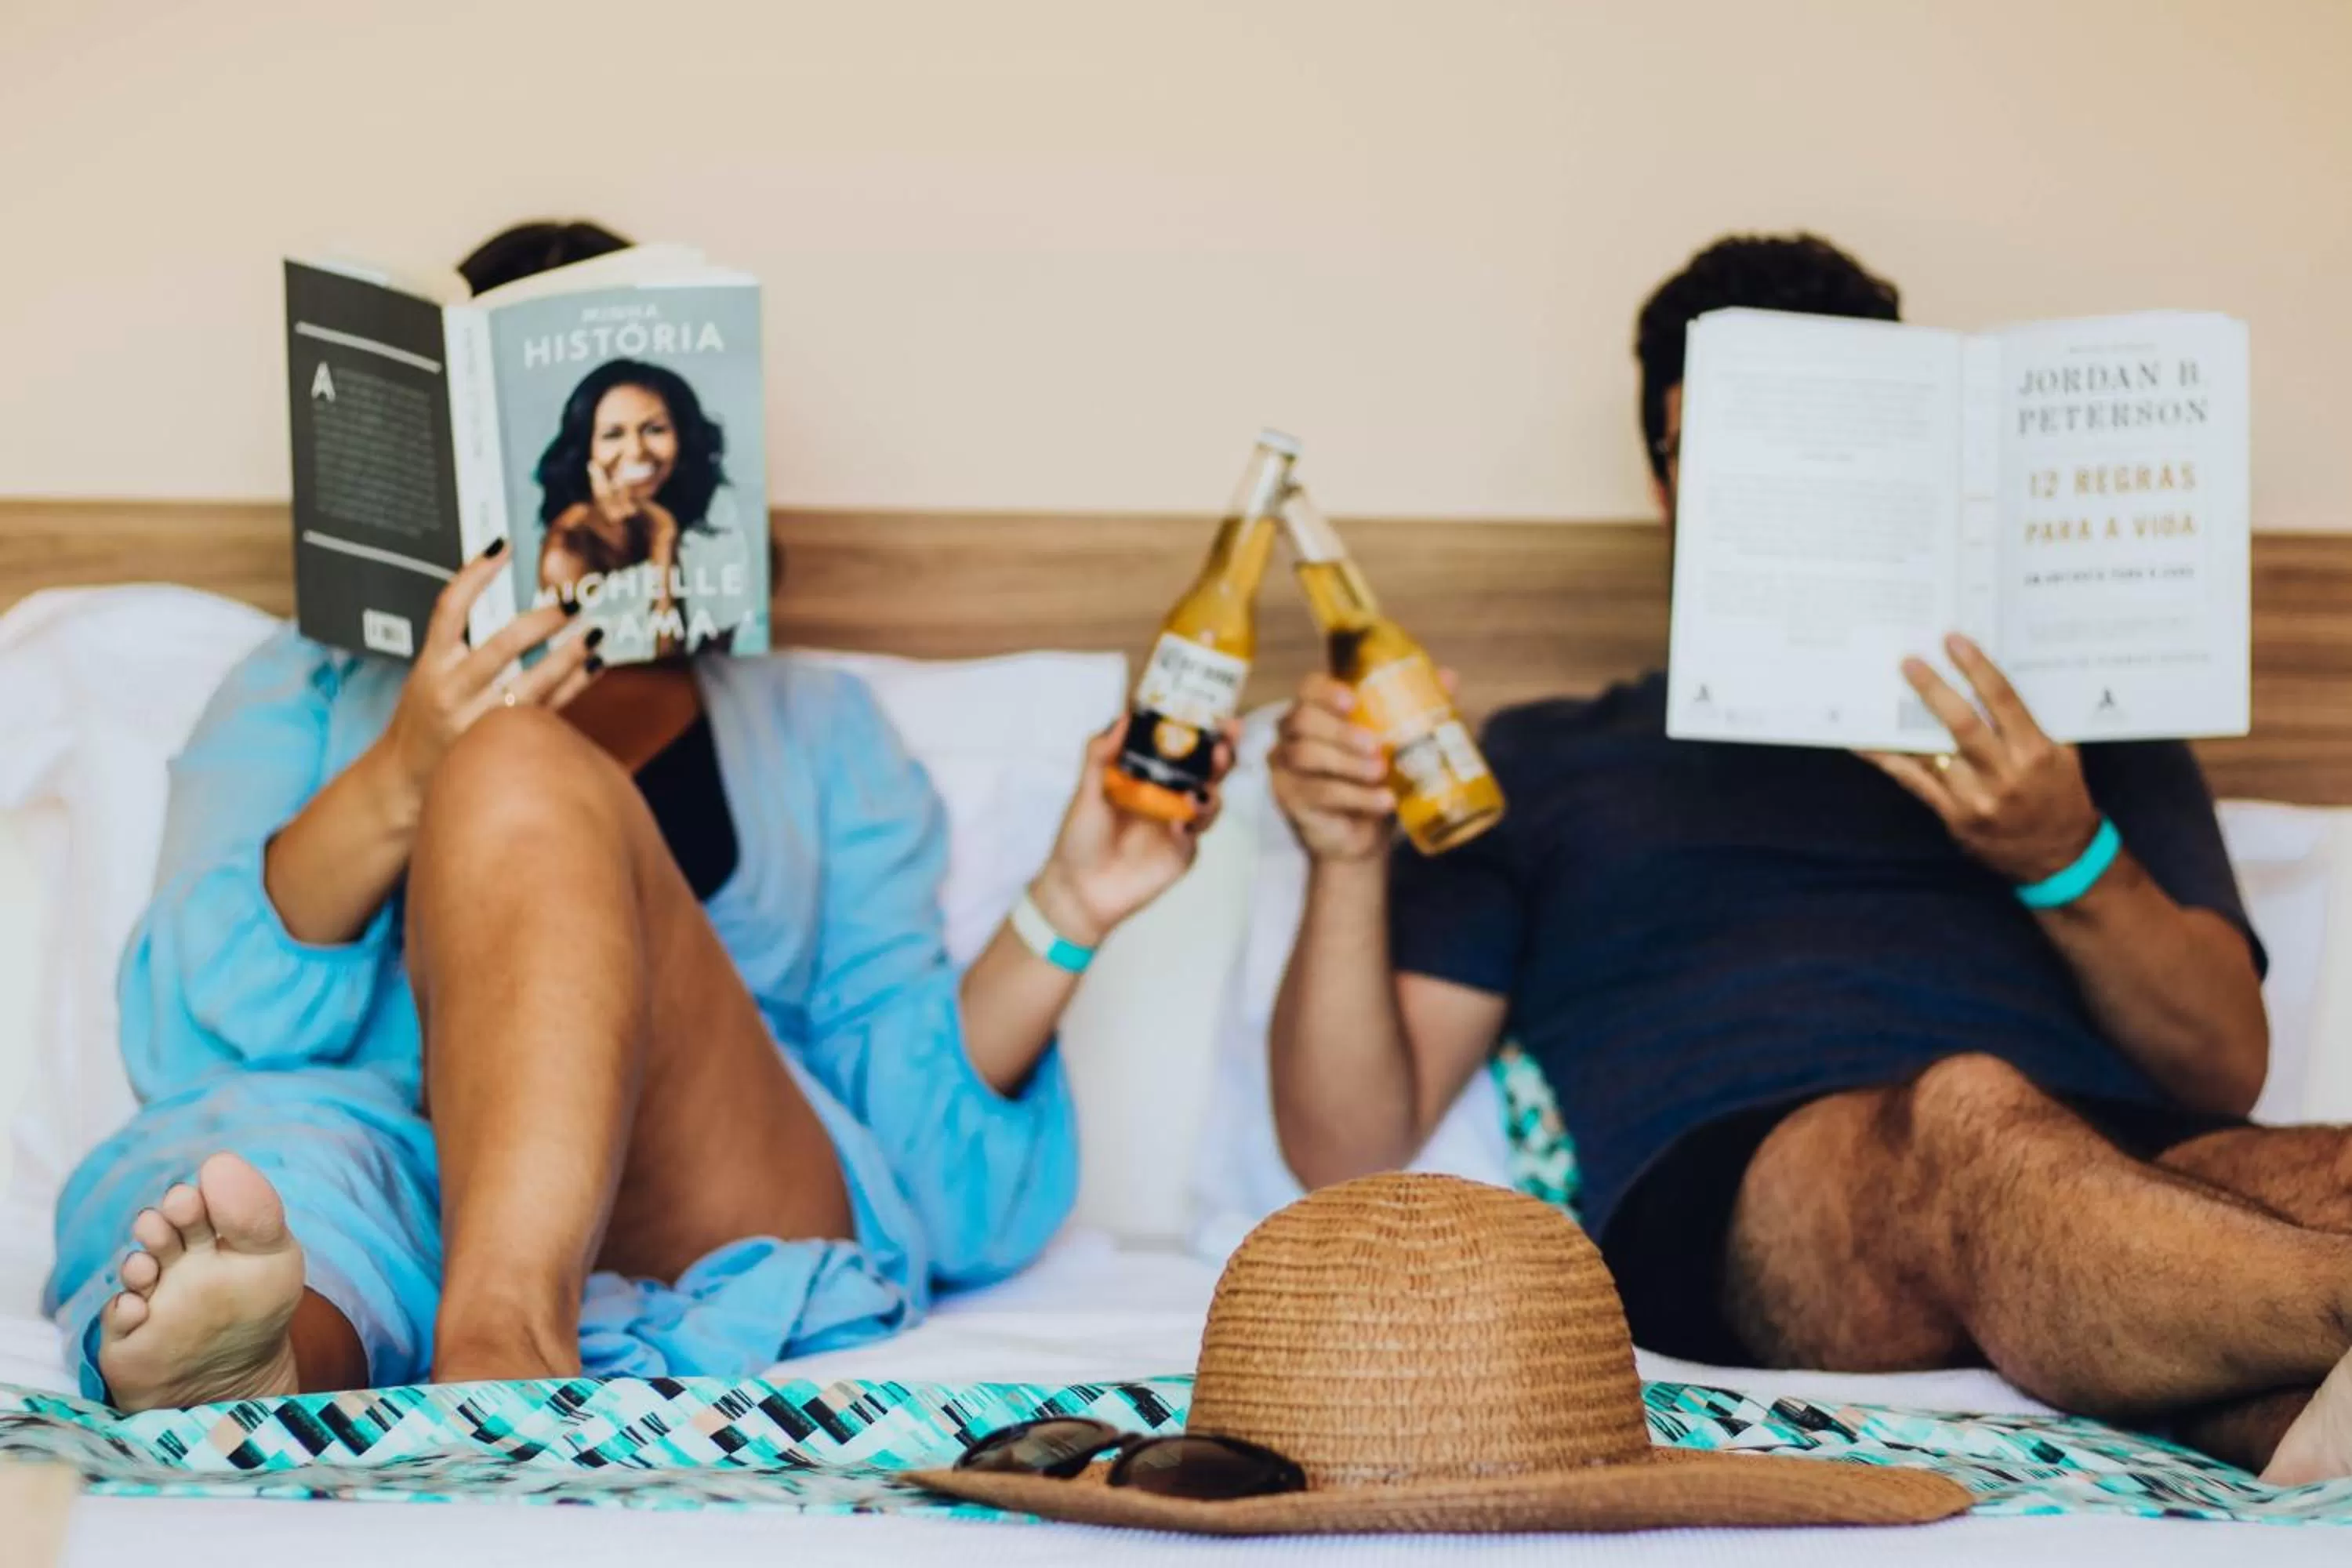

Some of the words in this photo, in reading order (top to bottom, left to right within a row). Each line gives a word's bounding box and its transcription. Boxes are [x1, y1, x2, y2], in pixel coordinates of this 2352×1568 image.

[523, 320, 725, 370] HISTÓRIA
[2018, 360, 2161, 395] JORDAN
[2017, 396, 2209, 439] PETERSON
[2027, 468, 2060, 500] 12
[2073, 461, 2196, 496] REGRAS
[2105, 514, 2122, 541] A
[2131, 511, 2199, 541] VIDA
